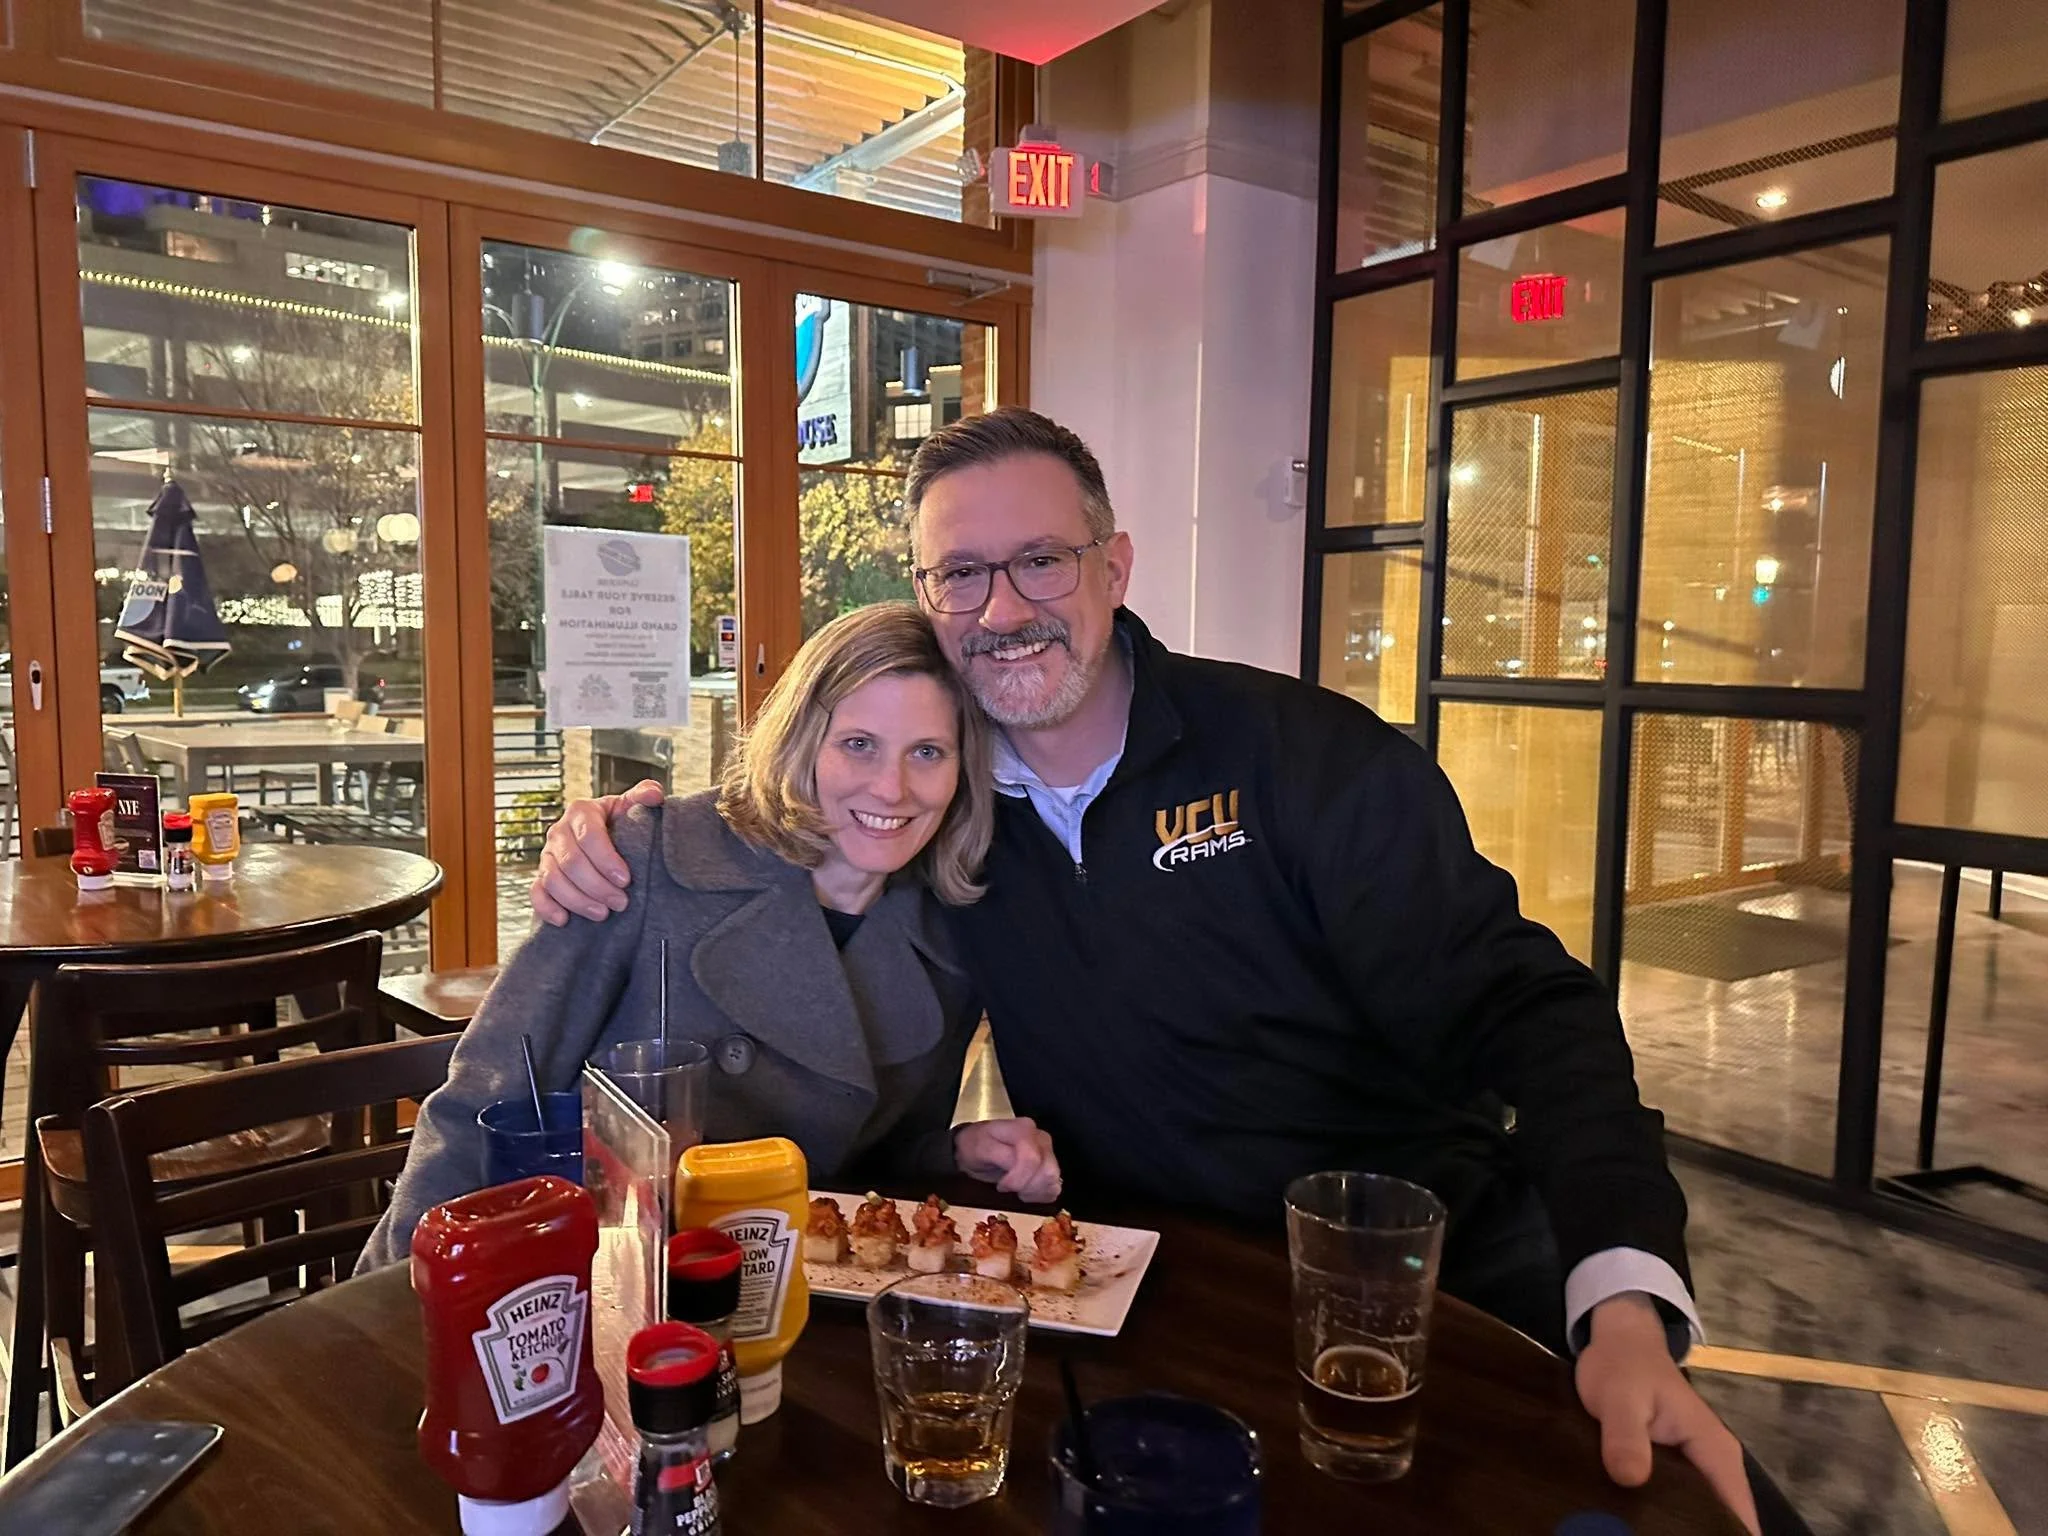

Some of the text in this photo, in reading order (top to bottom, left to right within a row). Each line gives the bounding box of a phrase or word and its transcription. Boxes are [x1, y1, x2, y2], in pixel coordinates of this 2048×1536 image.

[1009, 151, 1073, 207] EXIT
[1512, 278, 1567, 323] EXIT
[118, 799, 140, 816] NYE
[1155, 788, 1239, 846] VCU
[1170, 829, 1246, 865] RAMS
[743, 1260, 775, 1276] TARD
[510, 1293, 561, 1324] HEINZ
[507, 1316, 566, 1351] TOMATO
[511, 1331, 565, 1362] KETCHUP
